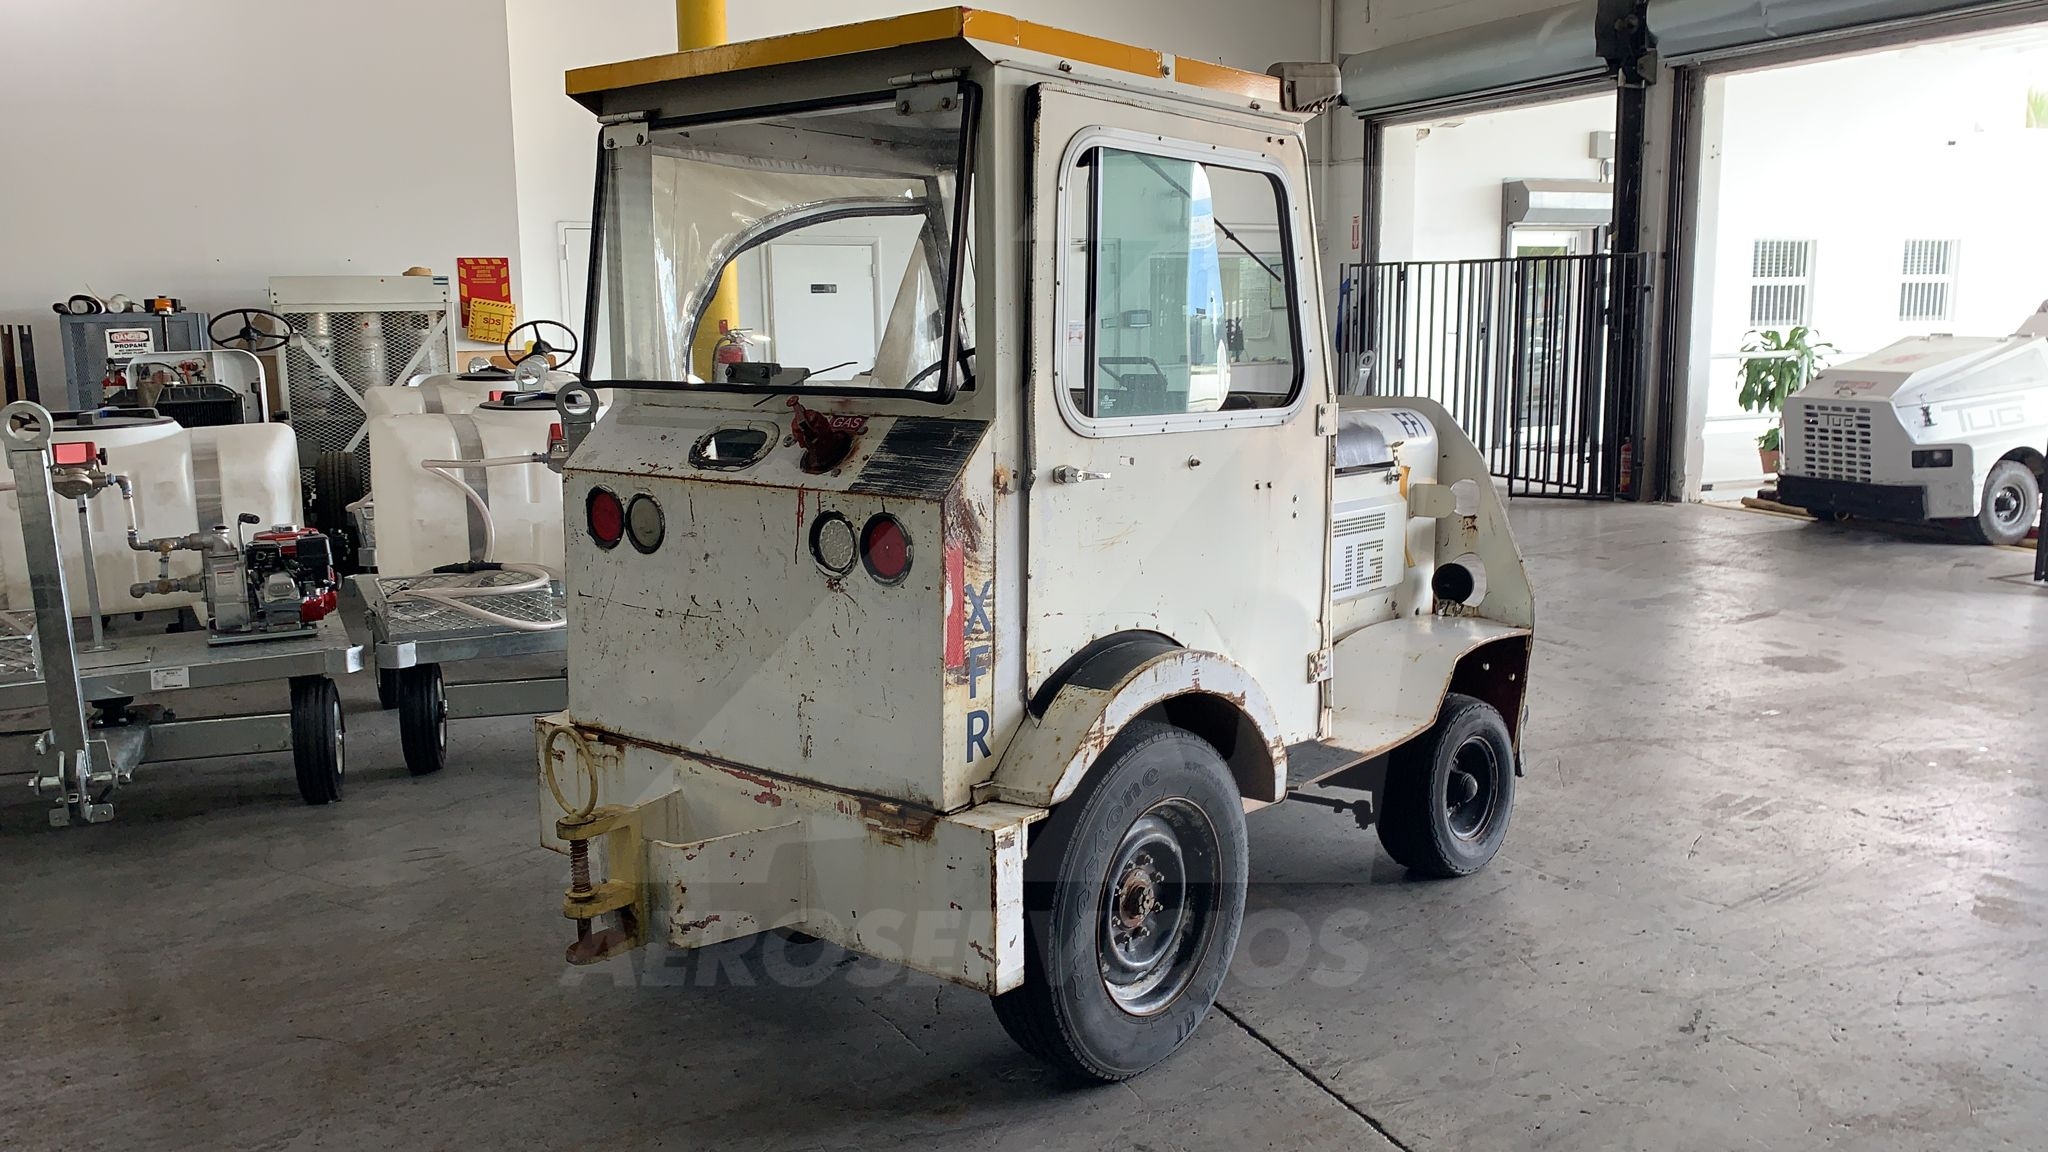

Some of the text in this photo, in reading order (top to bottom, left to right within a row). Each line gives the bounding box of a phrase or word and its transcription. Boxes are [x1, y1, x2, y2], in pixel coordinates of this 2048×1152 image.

[483, 317, 502, 326] SDS
[1820, 413, 1854, 428] TUG
[1941, 395, 2026, 433] TUG
[832, 416, 863, 428] GAS
[1391, 411, 1428, 438] EFI
